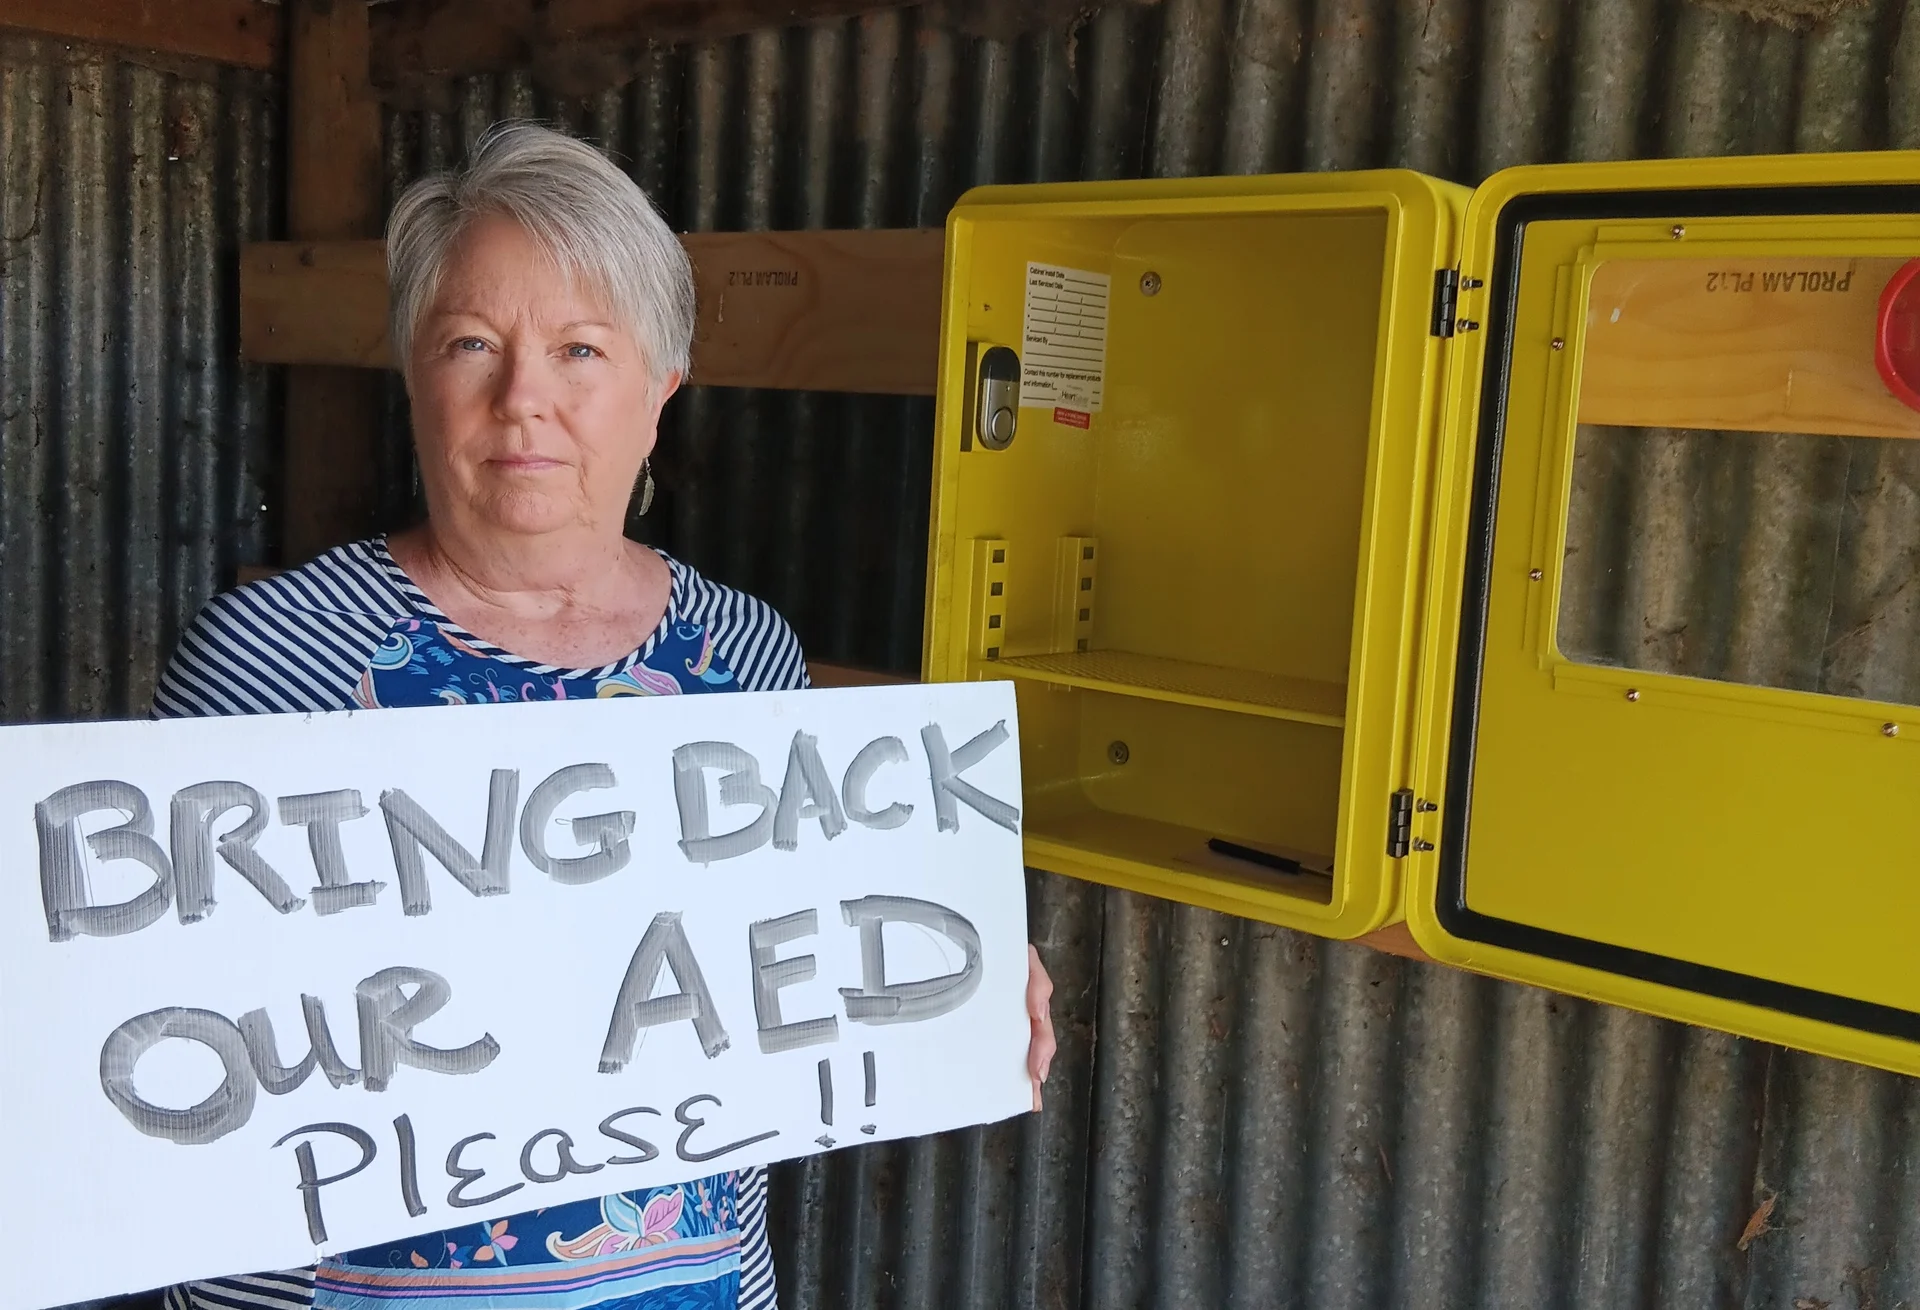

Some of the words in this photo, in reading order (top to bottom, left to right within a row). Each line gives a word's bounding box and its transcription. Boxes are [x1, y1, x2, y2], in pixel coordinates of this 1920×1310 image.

[729, 271, 753, 287] PL12
[756, 271, 798, 287] PROLAM
[1705, 271, 1755, 293] PL12
[1762, 271, 1852, 293] PROLAM
[1024, 368, 1038, 376] Contact
[1066, 373, 1086, 381] replacement
[1031, 380, 1051, 388] information
[35, 761, 638, 943] BRING
[671, 718, 1020, 867] BACK
[597, 893, 984, 1074] AED
